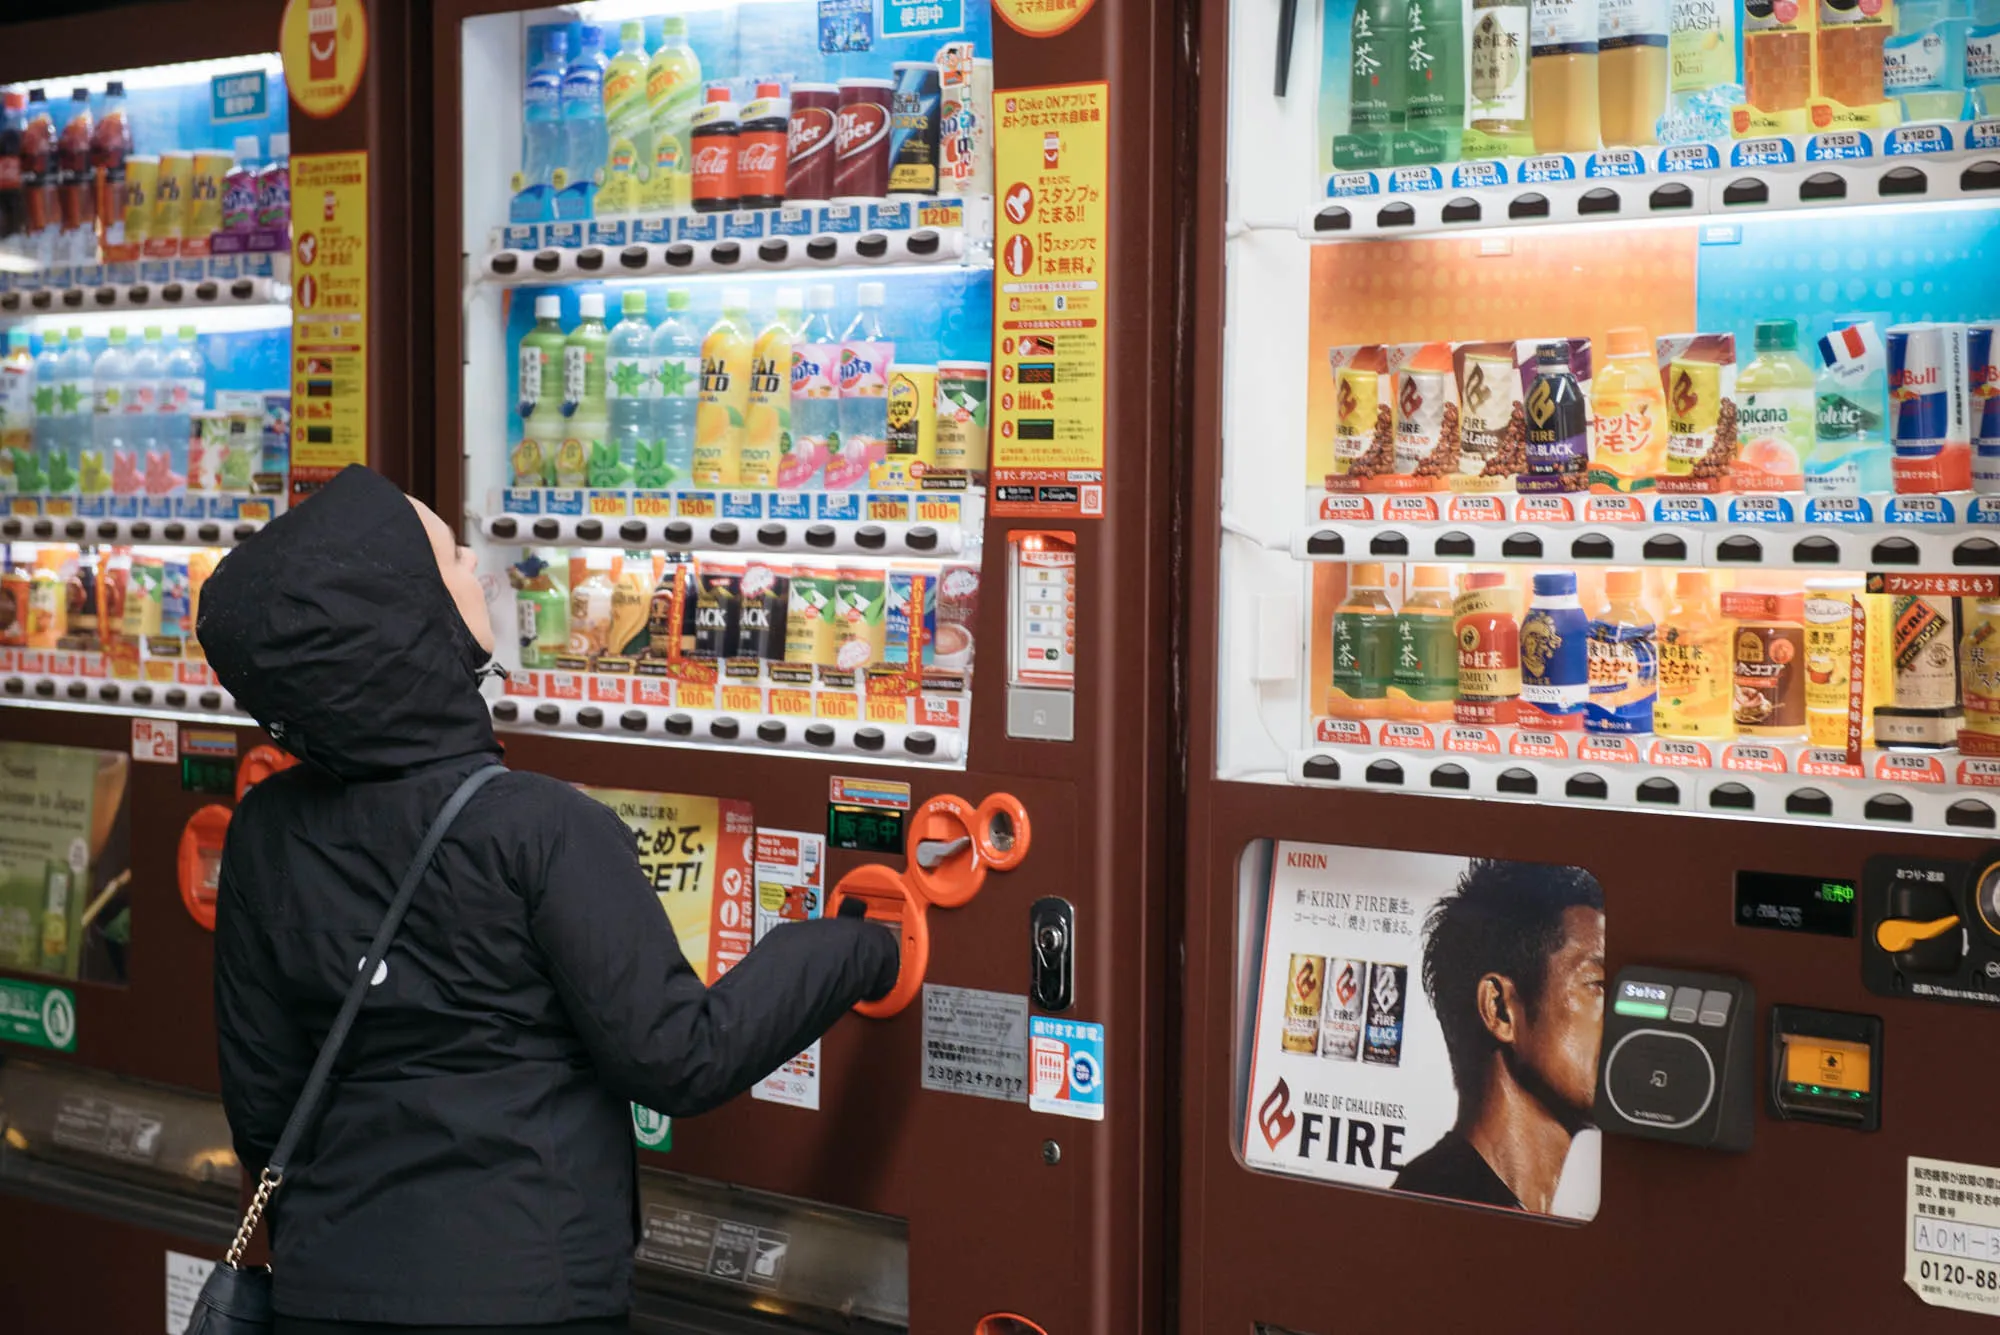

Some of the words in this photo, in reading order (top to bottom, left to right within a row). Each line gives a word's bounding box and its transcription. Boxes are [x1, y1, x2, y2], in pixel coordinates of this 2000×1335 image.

[1355, 9, 1381, 76] 生茶
[1409, 3, 1435, 71] 生茶
[1967, 44, 1993, 56] No.1
[1038, 185, 1099, 204] スタンプが
[1037, 232, 1097, 253] 15スタンプで
[1903, 367, 1937, 385] Bull
[1890, 577, 1995, 593] ブレンドを楽しもう
[1337, 621, 1356, 667] 生茶
[1399, 621, 1418, 667] 生茶
[1287, 852, 1328, 870] KIRIN
[1625, 983, 1667, 1000] Suica
[1294, 1004, 1313, 1016] FIRE
[1334, 1009, 1354, 1020] FIRE
[1304, 1092, 1329, 1109] MADE
[1332, 1096, 1344, 1110] OF
[1346, 1098, 1408, 1120] CHALLENGES.
[1298, 1112, 1406, 1173] FIRE
[1918, 1203, 1956, 1218] 管理番号
